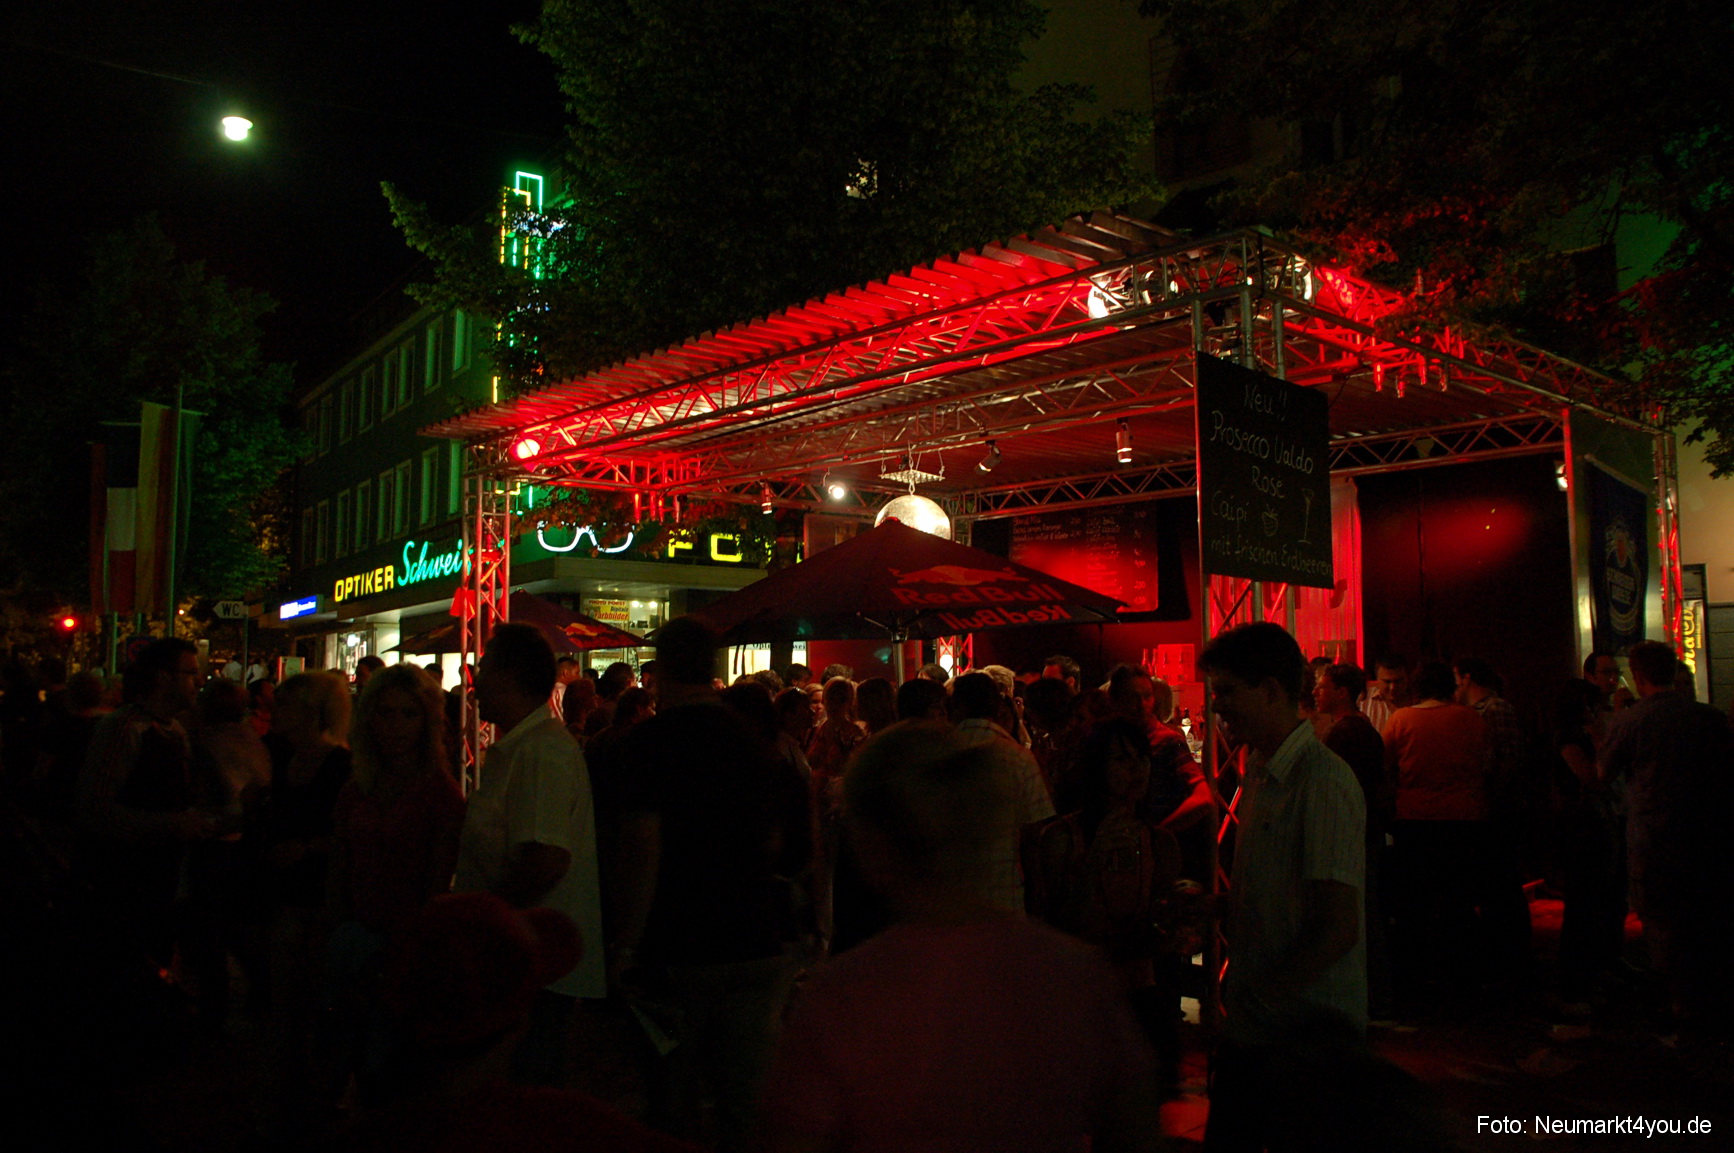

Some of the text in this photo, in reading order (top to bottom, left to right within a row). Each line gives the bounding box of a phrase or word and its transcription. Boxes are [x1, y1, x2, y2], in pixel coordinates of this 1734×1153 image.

[1210, 410, 1270, 459] Prosecco
[1211, 490, 1250, 531] Caipi
[334, 565, 394, 603] OPTIKER
[891, 583, 1066, 604] Red Bull
[222, 603, 241, 617] WC
